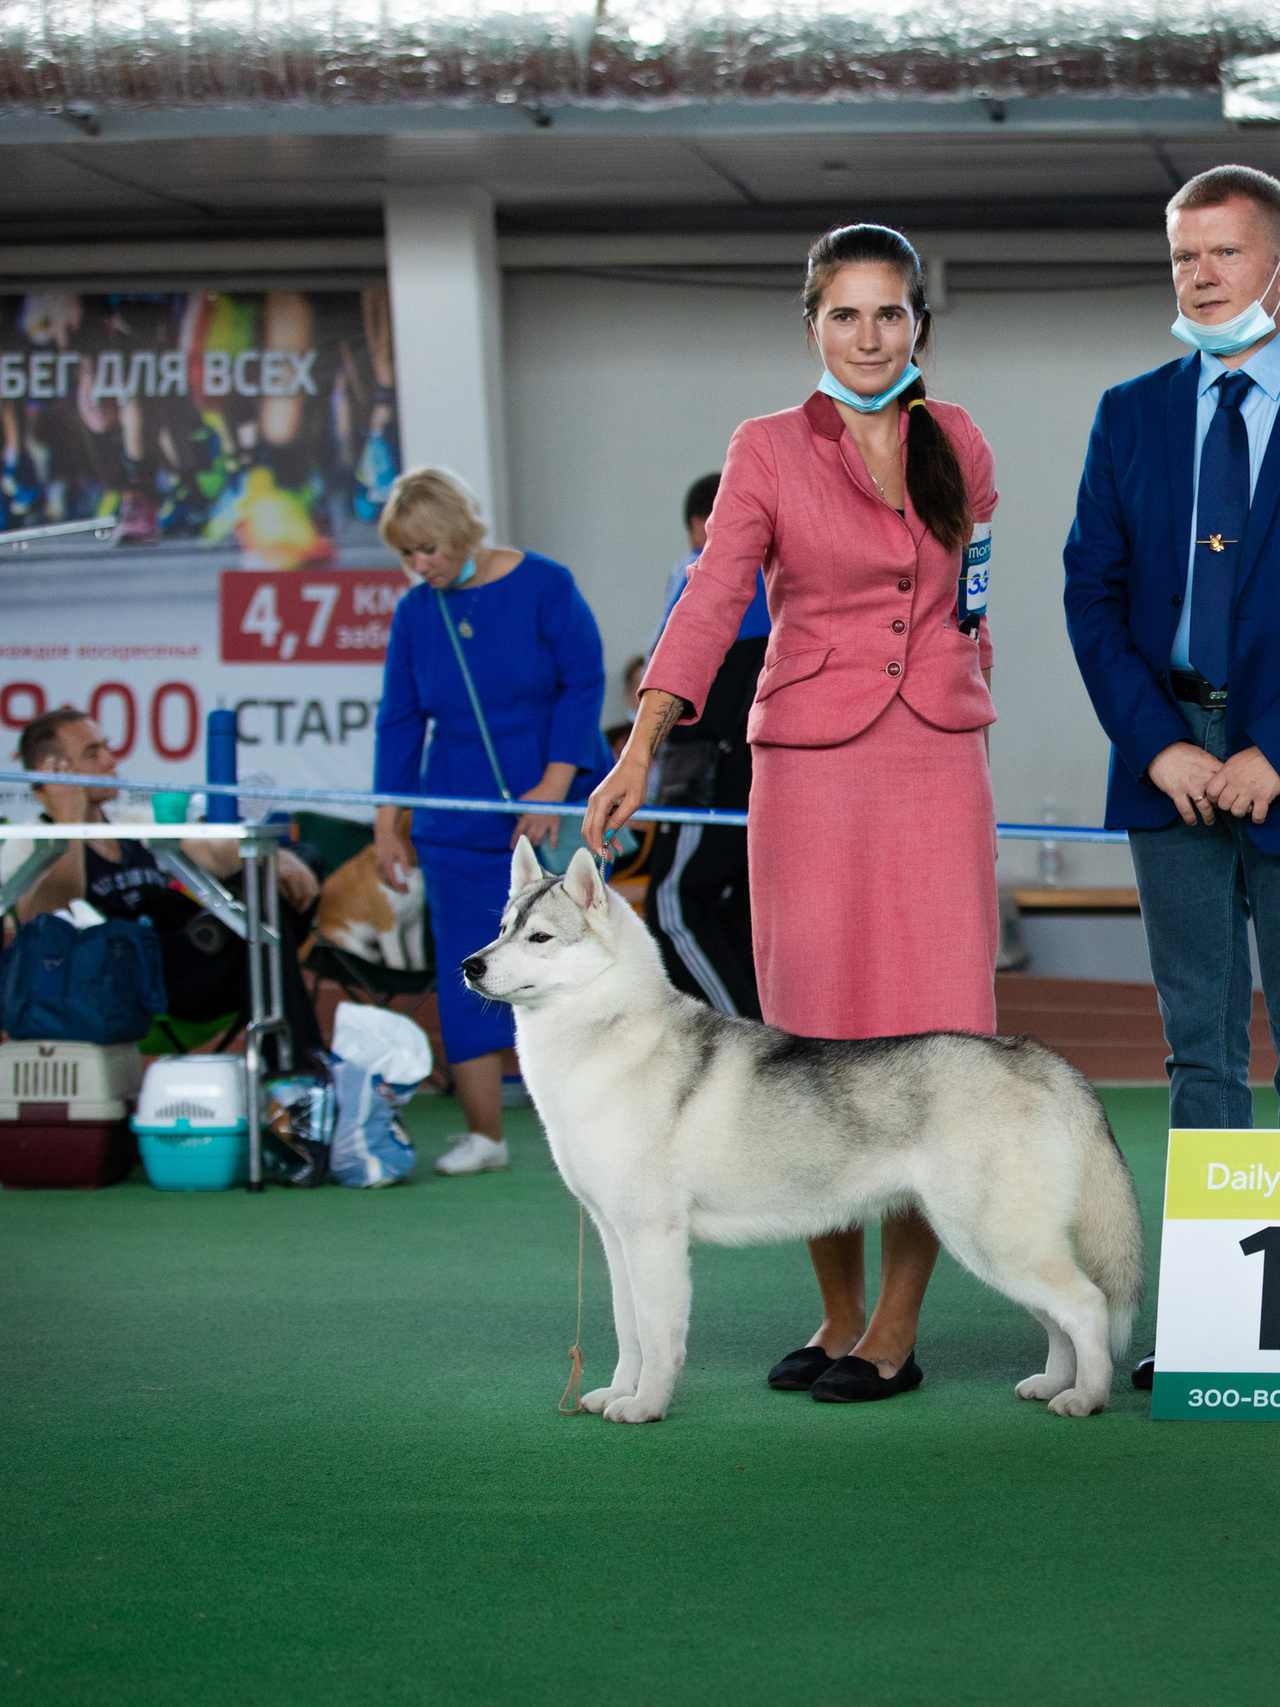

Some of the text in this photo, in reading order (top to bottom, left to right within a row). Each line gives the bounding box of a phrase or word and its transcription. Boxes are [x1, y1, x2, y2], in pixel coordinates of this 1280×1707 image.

[1, 350, 319, 406] БЕГ ДЛЯ ВСЕХ
[968, 544, 991, 559] mon
[241, 584, 340, 660] 4,7
[235, 698, 379, 744] СТАР
